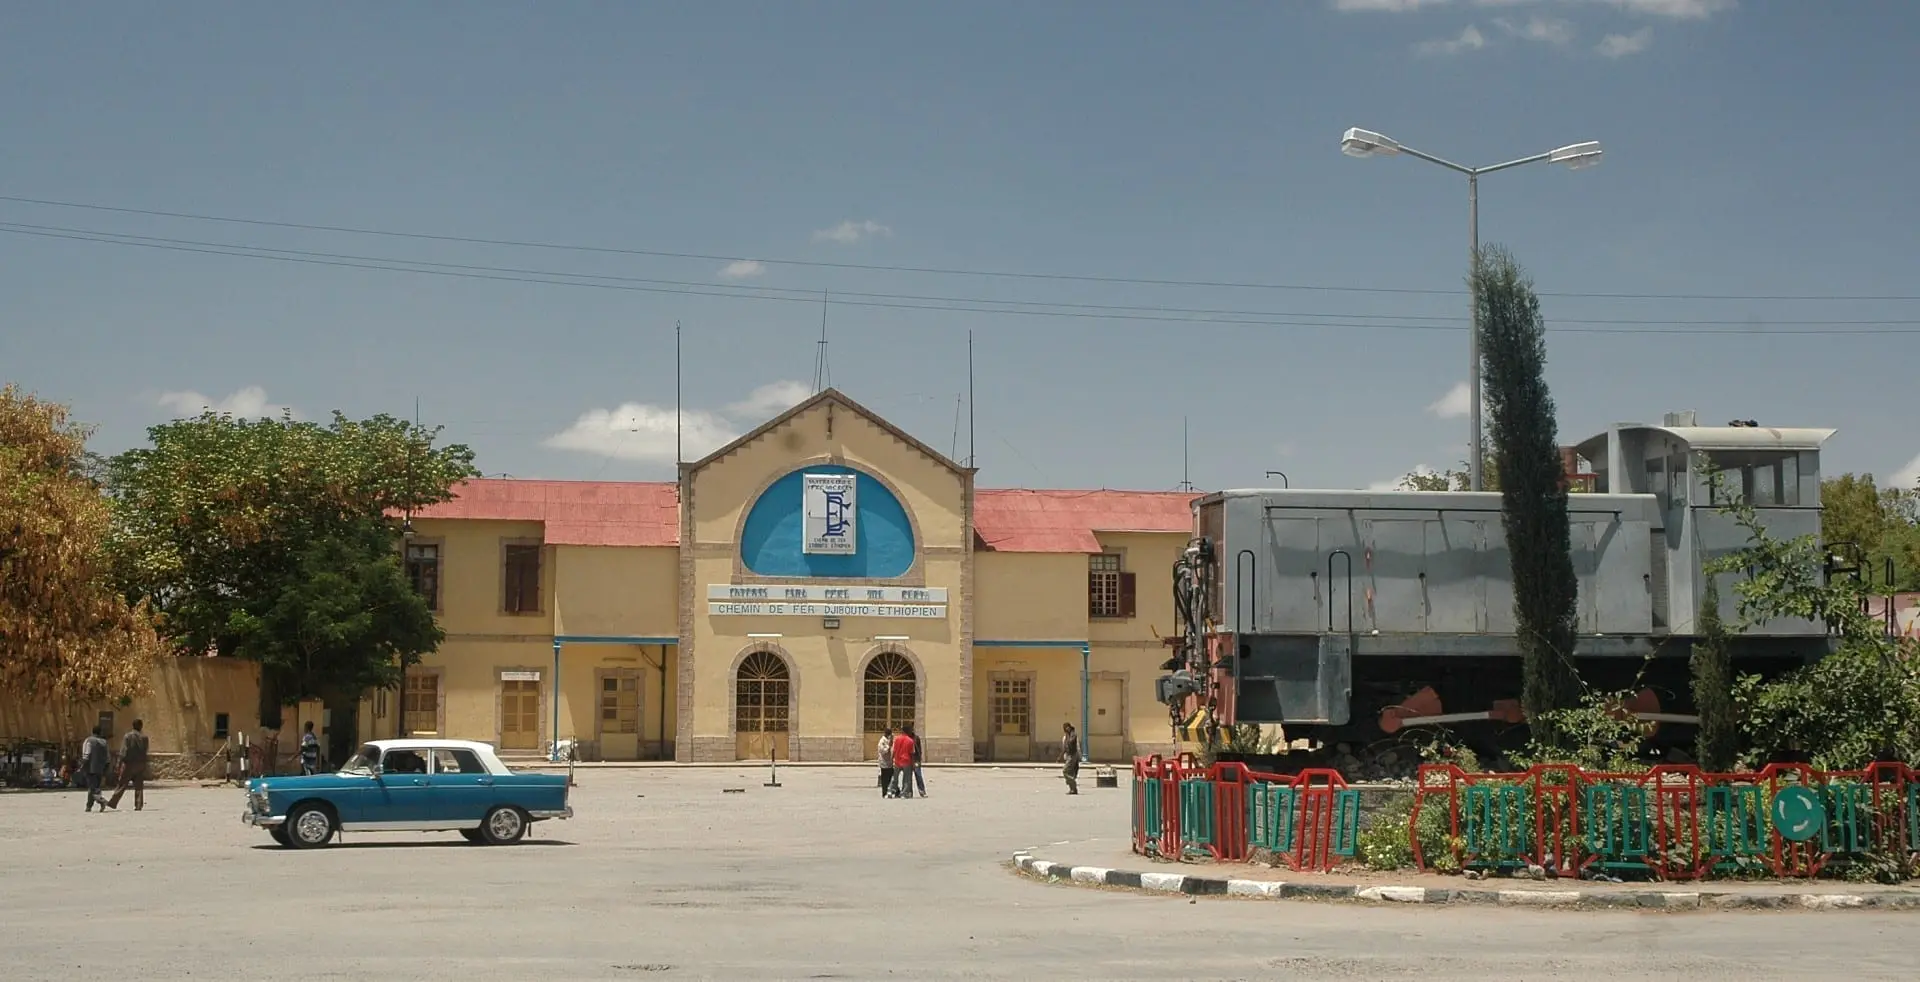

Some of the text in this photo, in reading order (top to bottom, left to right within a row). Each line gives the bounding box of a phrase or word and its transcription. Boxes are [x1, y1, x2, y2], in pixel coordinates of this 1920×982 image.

[718, 605, 760, 614] CHEMIN
[769, 605, 783, 614] DE
[793, 605, 815, 614] FER
